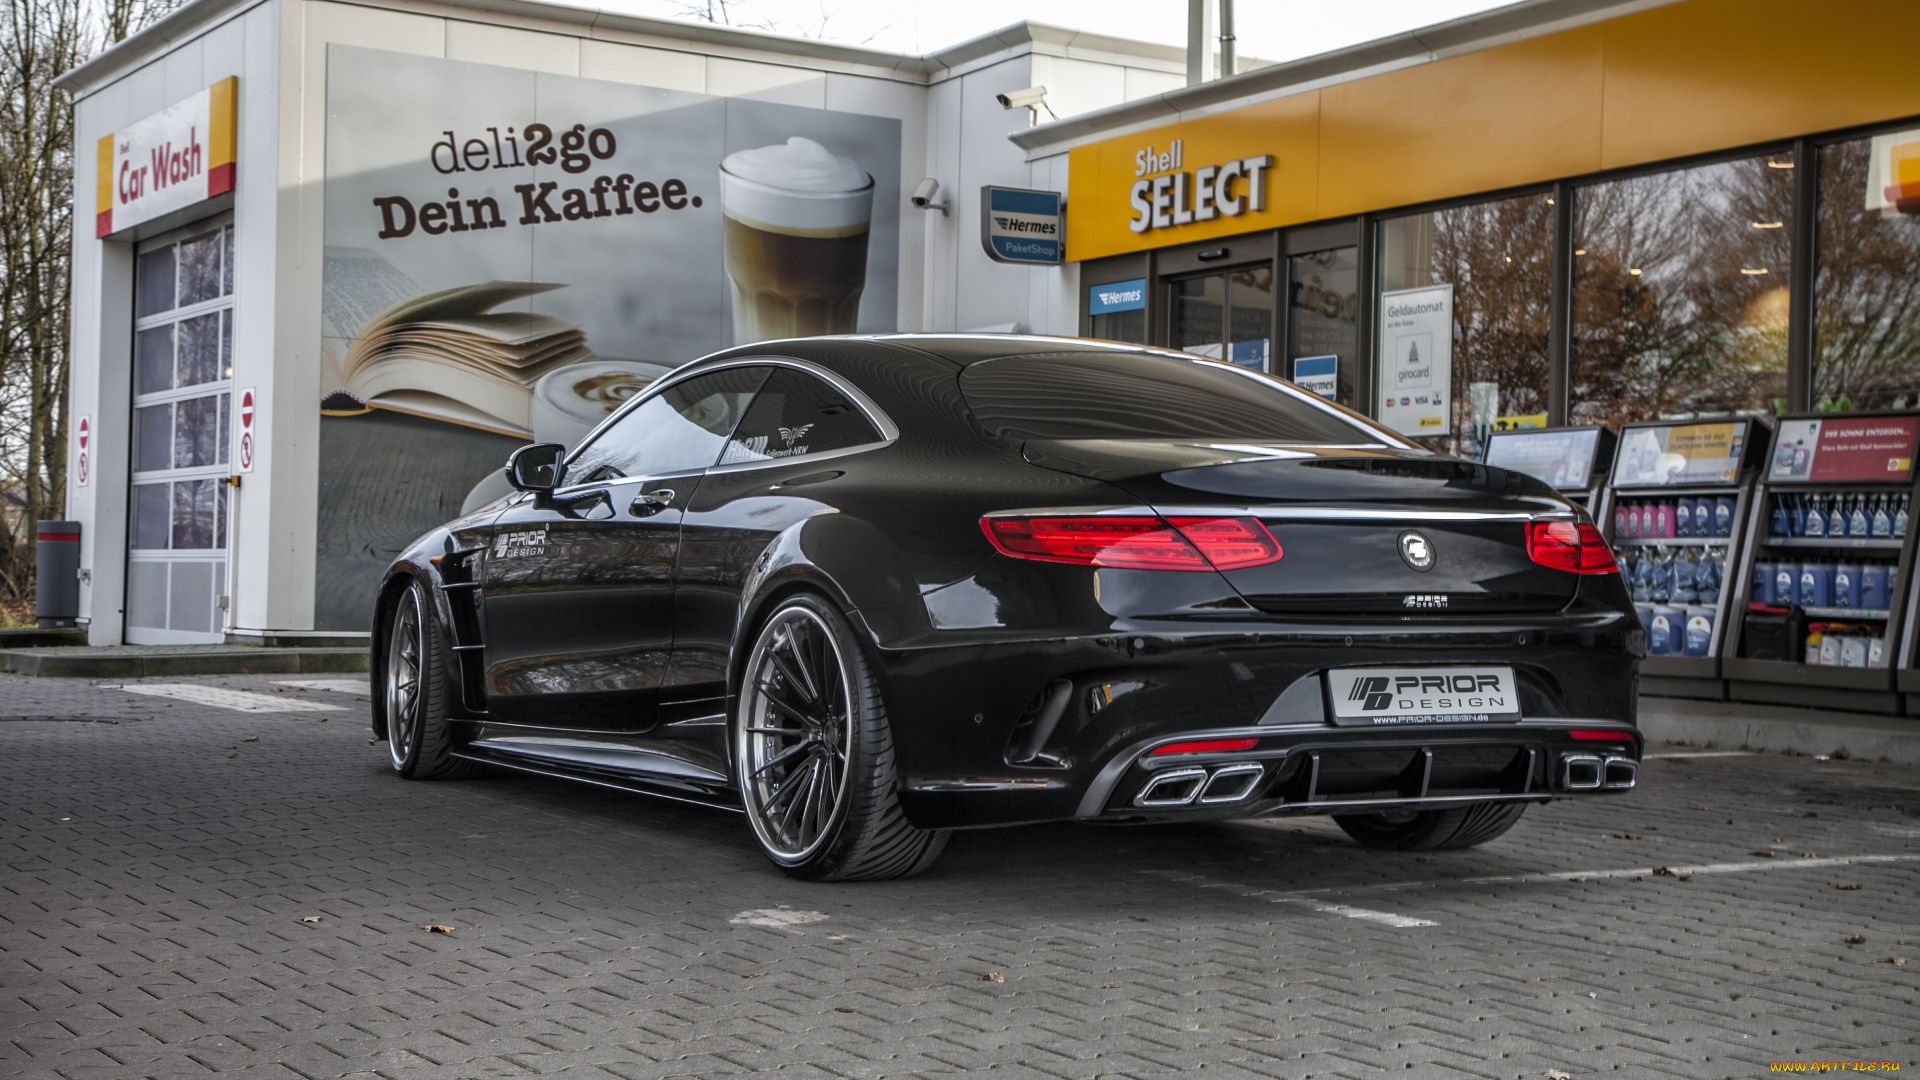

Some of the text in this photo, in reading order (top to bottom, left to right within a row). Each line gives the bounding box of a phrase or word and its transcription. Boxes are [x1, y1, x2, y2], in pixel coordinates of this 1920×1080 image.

[431, 123, 617, 174] deli2go
[119, 126, 201, 205] Car Wash
[1134, 139, 1183, 177] Shell
[1128, 155, 1274, 234] SELECT
[373, 173, 703, 239] Dein Kaffee.
[1008, 218, 1056, 234] Hermes
[1005, 242, 1056, 256] PaketShop
[1108, 290, 1141, 304] Hermes
[1387, 301, 1444, 318] Geldautomat
[1398, 366, 1430, 383] girocard
[1304, 379, 1334, 392] Hermes
[1415, 396, 1429, 404] VISA
[508, 530, 546, 547] PRIOR
[507, 547, 545, 557] DESIGN
[1395, 674, 1501, 694] PRIOR
[1398, 697, 1505, 710] DESIGN
[1372, 714, 1489, 724] www.PRIOR-DESIGN.de
